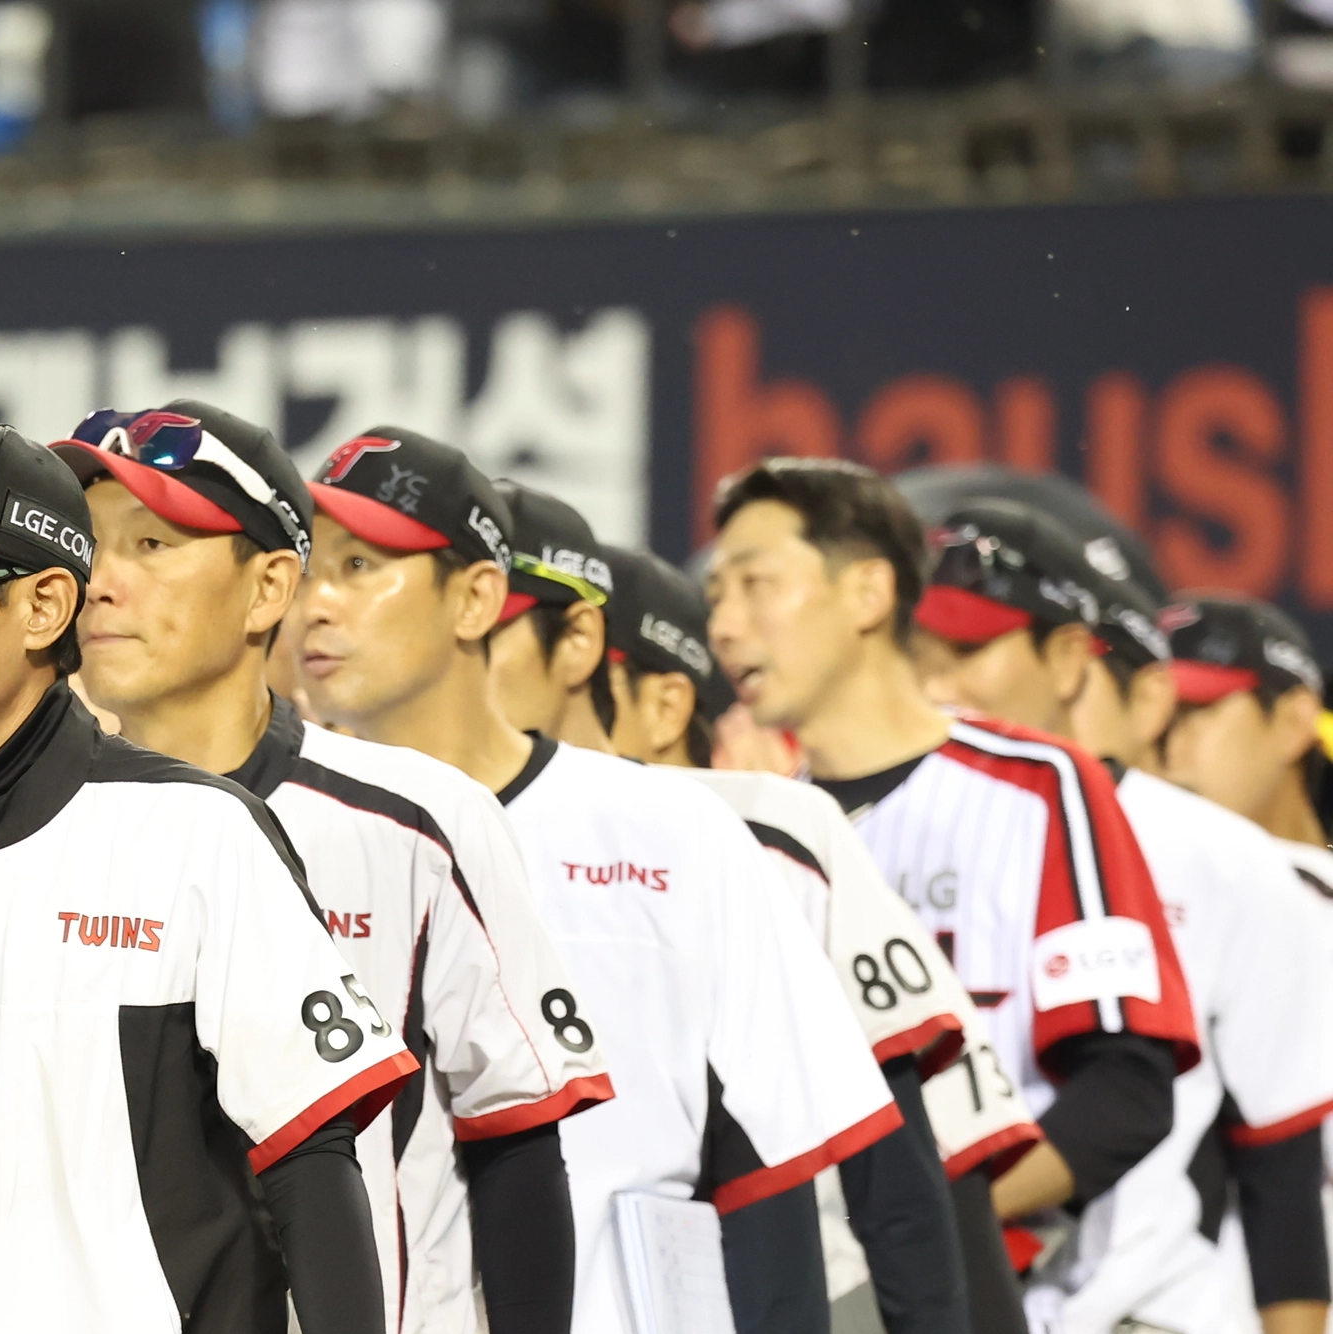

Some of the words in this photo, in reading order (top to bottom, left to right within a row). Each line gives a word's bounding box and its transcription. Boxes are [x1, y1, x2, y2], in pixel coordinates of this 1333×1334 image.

[9, 501, 93, 568] LGE.COM
[561, 859, 669, 893] TWINS
[57, 911, 165, 952] TWINS
[852, 936, 933, 1012] 80
[300, 972, 393, 1064] 85
